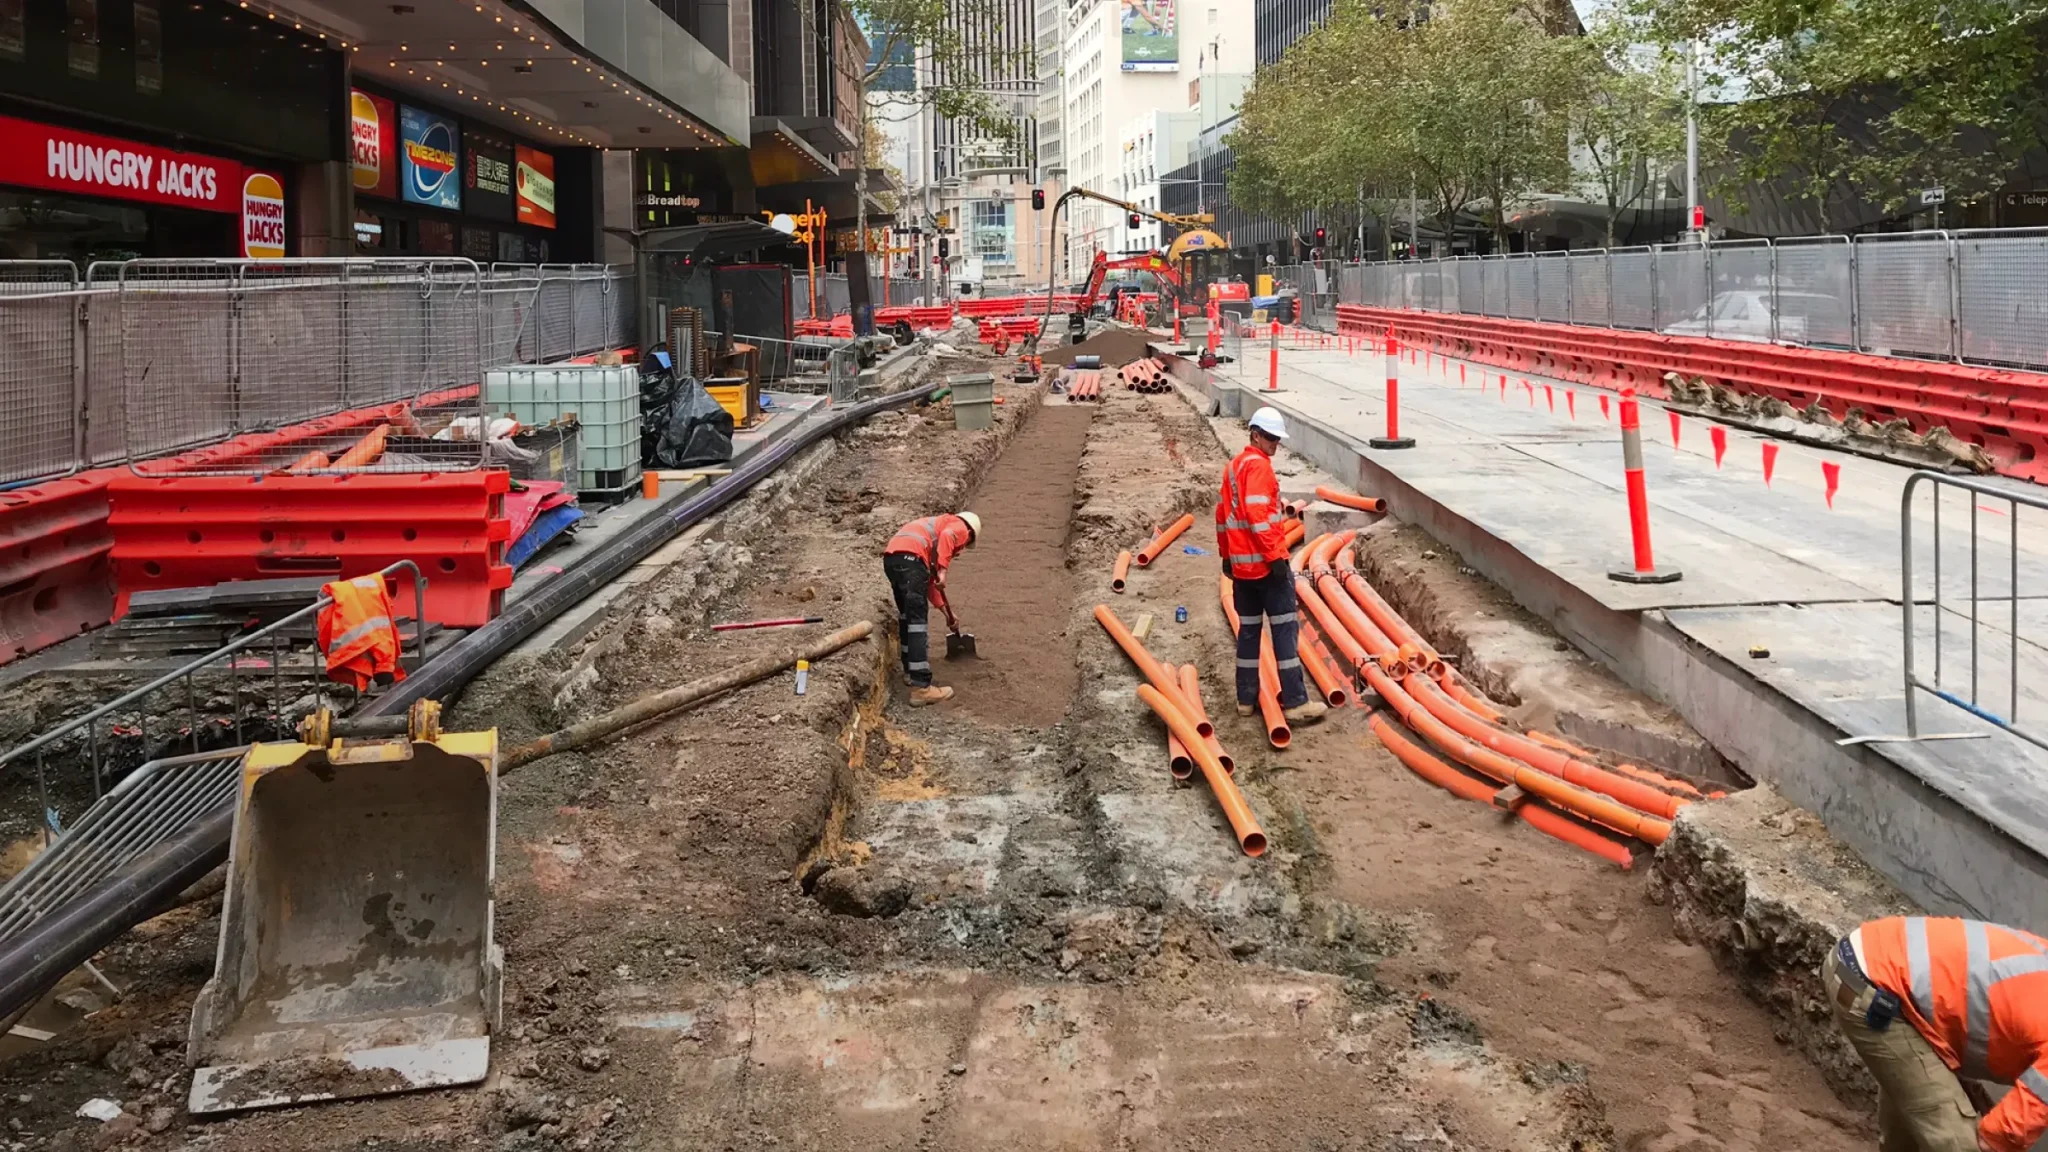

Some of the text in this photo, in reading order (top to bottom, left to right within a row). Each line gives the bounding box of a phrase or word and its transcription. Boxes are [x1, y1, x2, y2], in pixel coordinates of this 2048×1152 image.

[351, 121, 377, 143] UNGRY
[403, 138, 457, 168] TIMEZONE
[47, 138, 217, 200] HUNGRY JACK'S
[246, 199, 283, 219] HUNGRY
[647, 194, 701, 208] Breadtop
